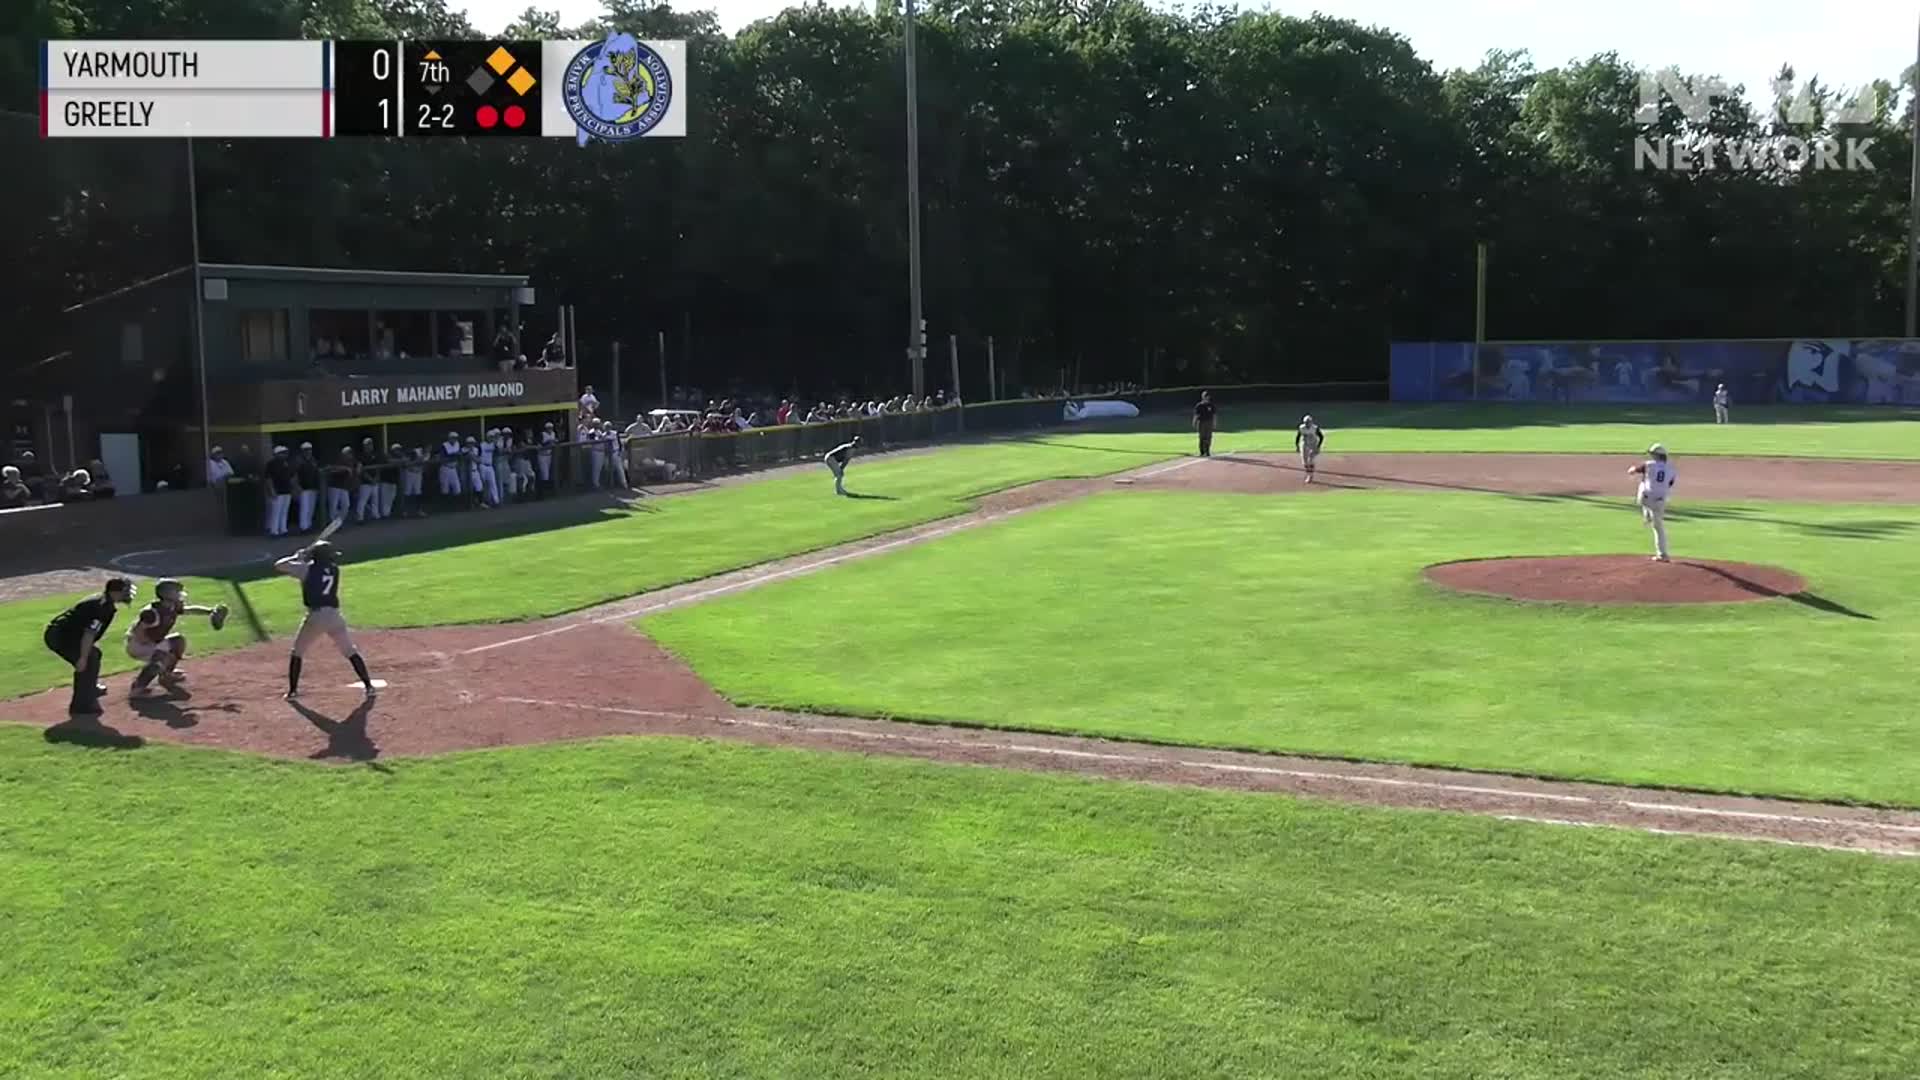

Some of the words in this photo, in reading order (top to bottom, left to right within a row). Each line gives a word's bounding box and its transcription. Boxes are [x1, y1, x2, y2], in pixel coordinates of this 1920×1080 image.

[341, 388, 389, 406] LARRY
[397, 384, 461, 403] MAHANEY
[468, 382, 524, 399] DIAMOND
[321, 575, 334, 595] 7
